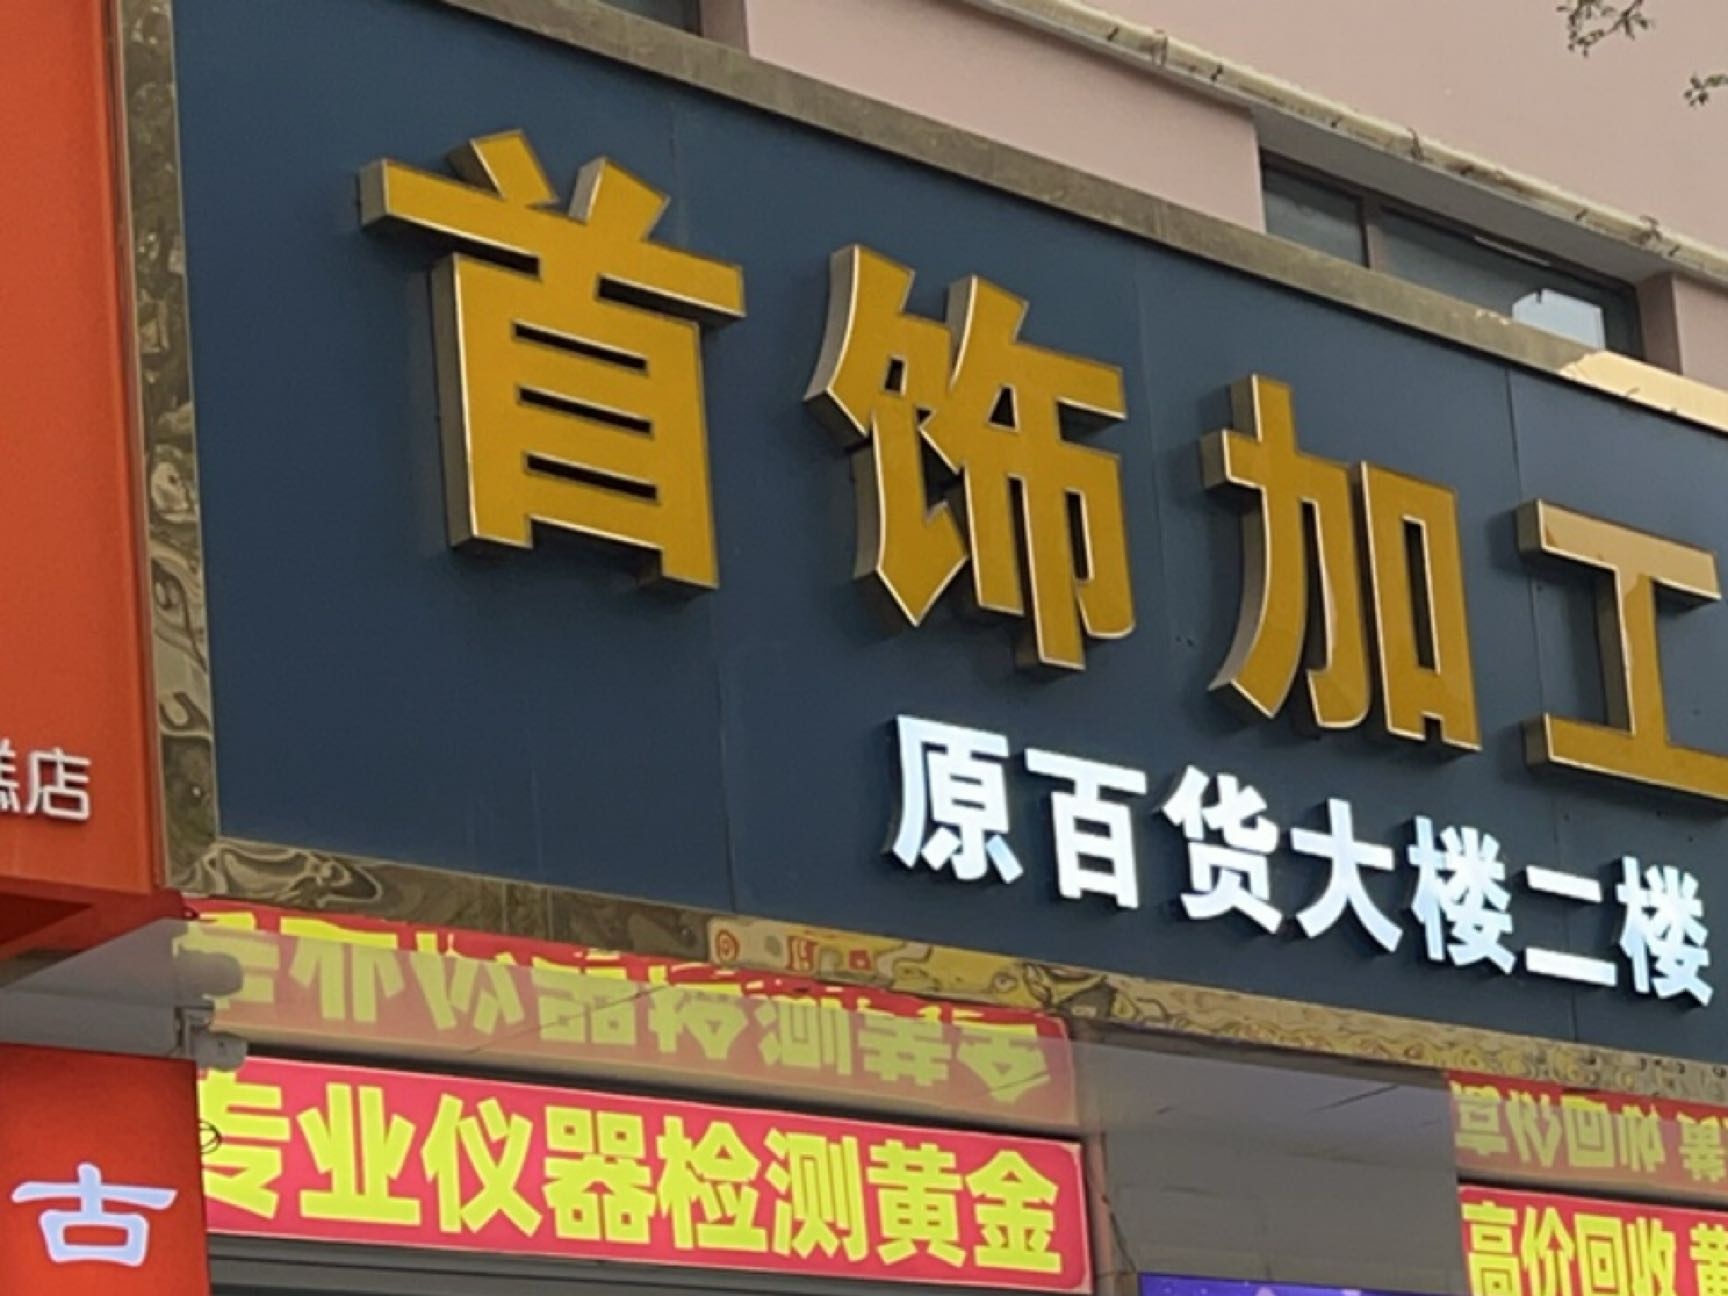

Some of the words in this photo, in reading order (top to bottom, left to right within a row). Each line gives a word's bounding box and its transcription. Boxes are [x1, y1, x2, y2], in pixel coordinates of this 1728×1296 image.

[886, 714, 1713, 1006] 原百货大楼二楼
[197, 1068, 1063, 1274] 专业仪器检测黄金
